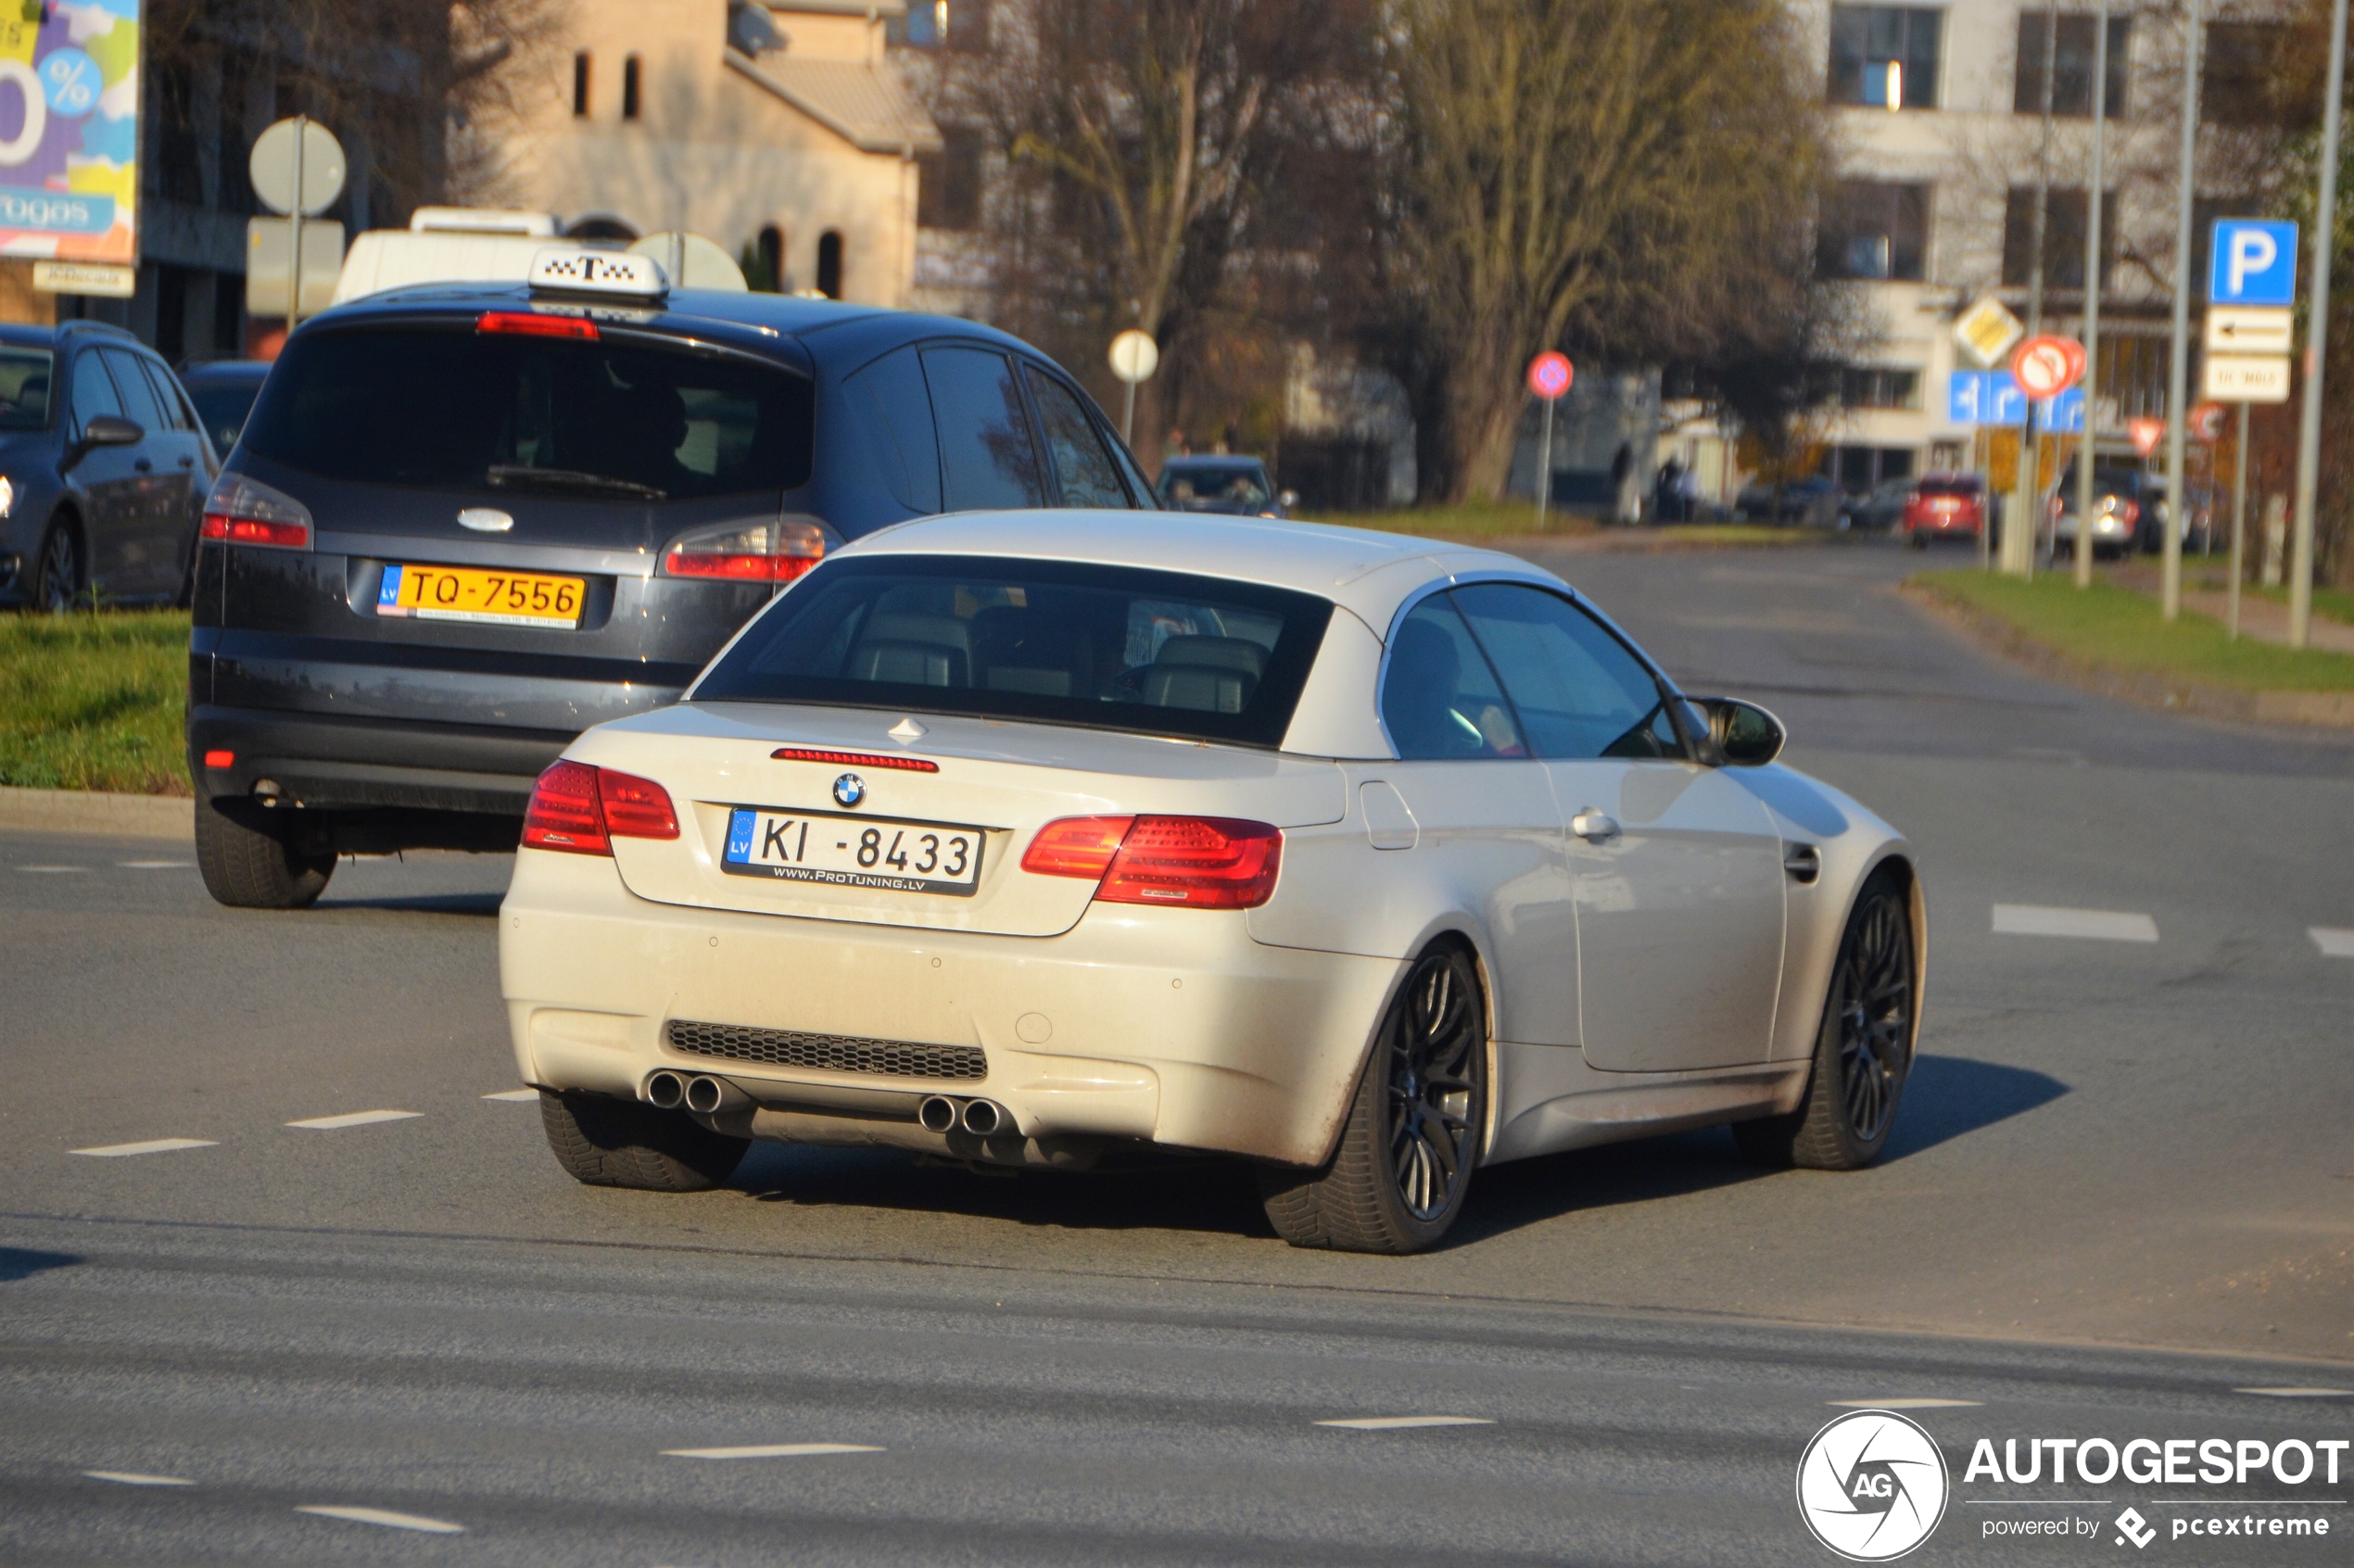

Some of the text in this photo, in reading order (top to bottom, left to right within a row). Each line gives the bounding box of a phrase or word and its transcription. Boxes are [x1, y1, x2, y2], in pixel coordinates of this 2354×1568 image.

[577, 255, 603, 280] T
[2229, 230, 2277, 295] P
[382, 589, 397, 600] LV
[412, 572, 575, 613] TQ-7556
[730, 841, 749, 854] LV
